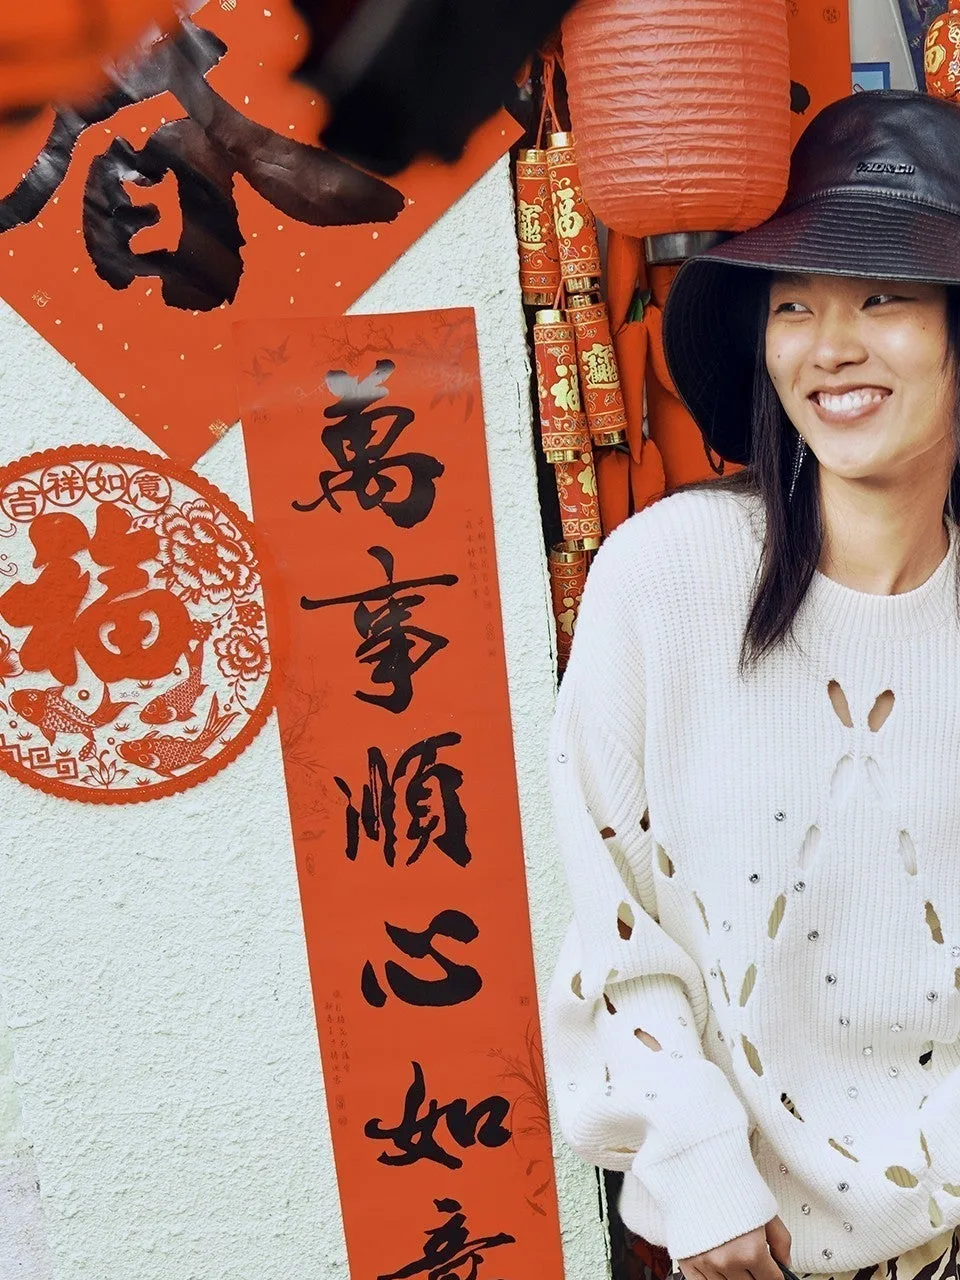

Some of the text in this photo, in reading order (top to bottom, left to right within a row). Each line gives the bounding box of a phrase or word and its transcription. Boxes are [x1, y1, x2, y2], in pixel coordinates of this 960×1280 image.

[9, 466, 170, 517] 吉祥如意
[0, 503, 191, 685] 福
